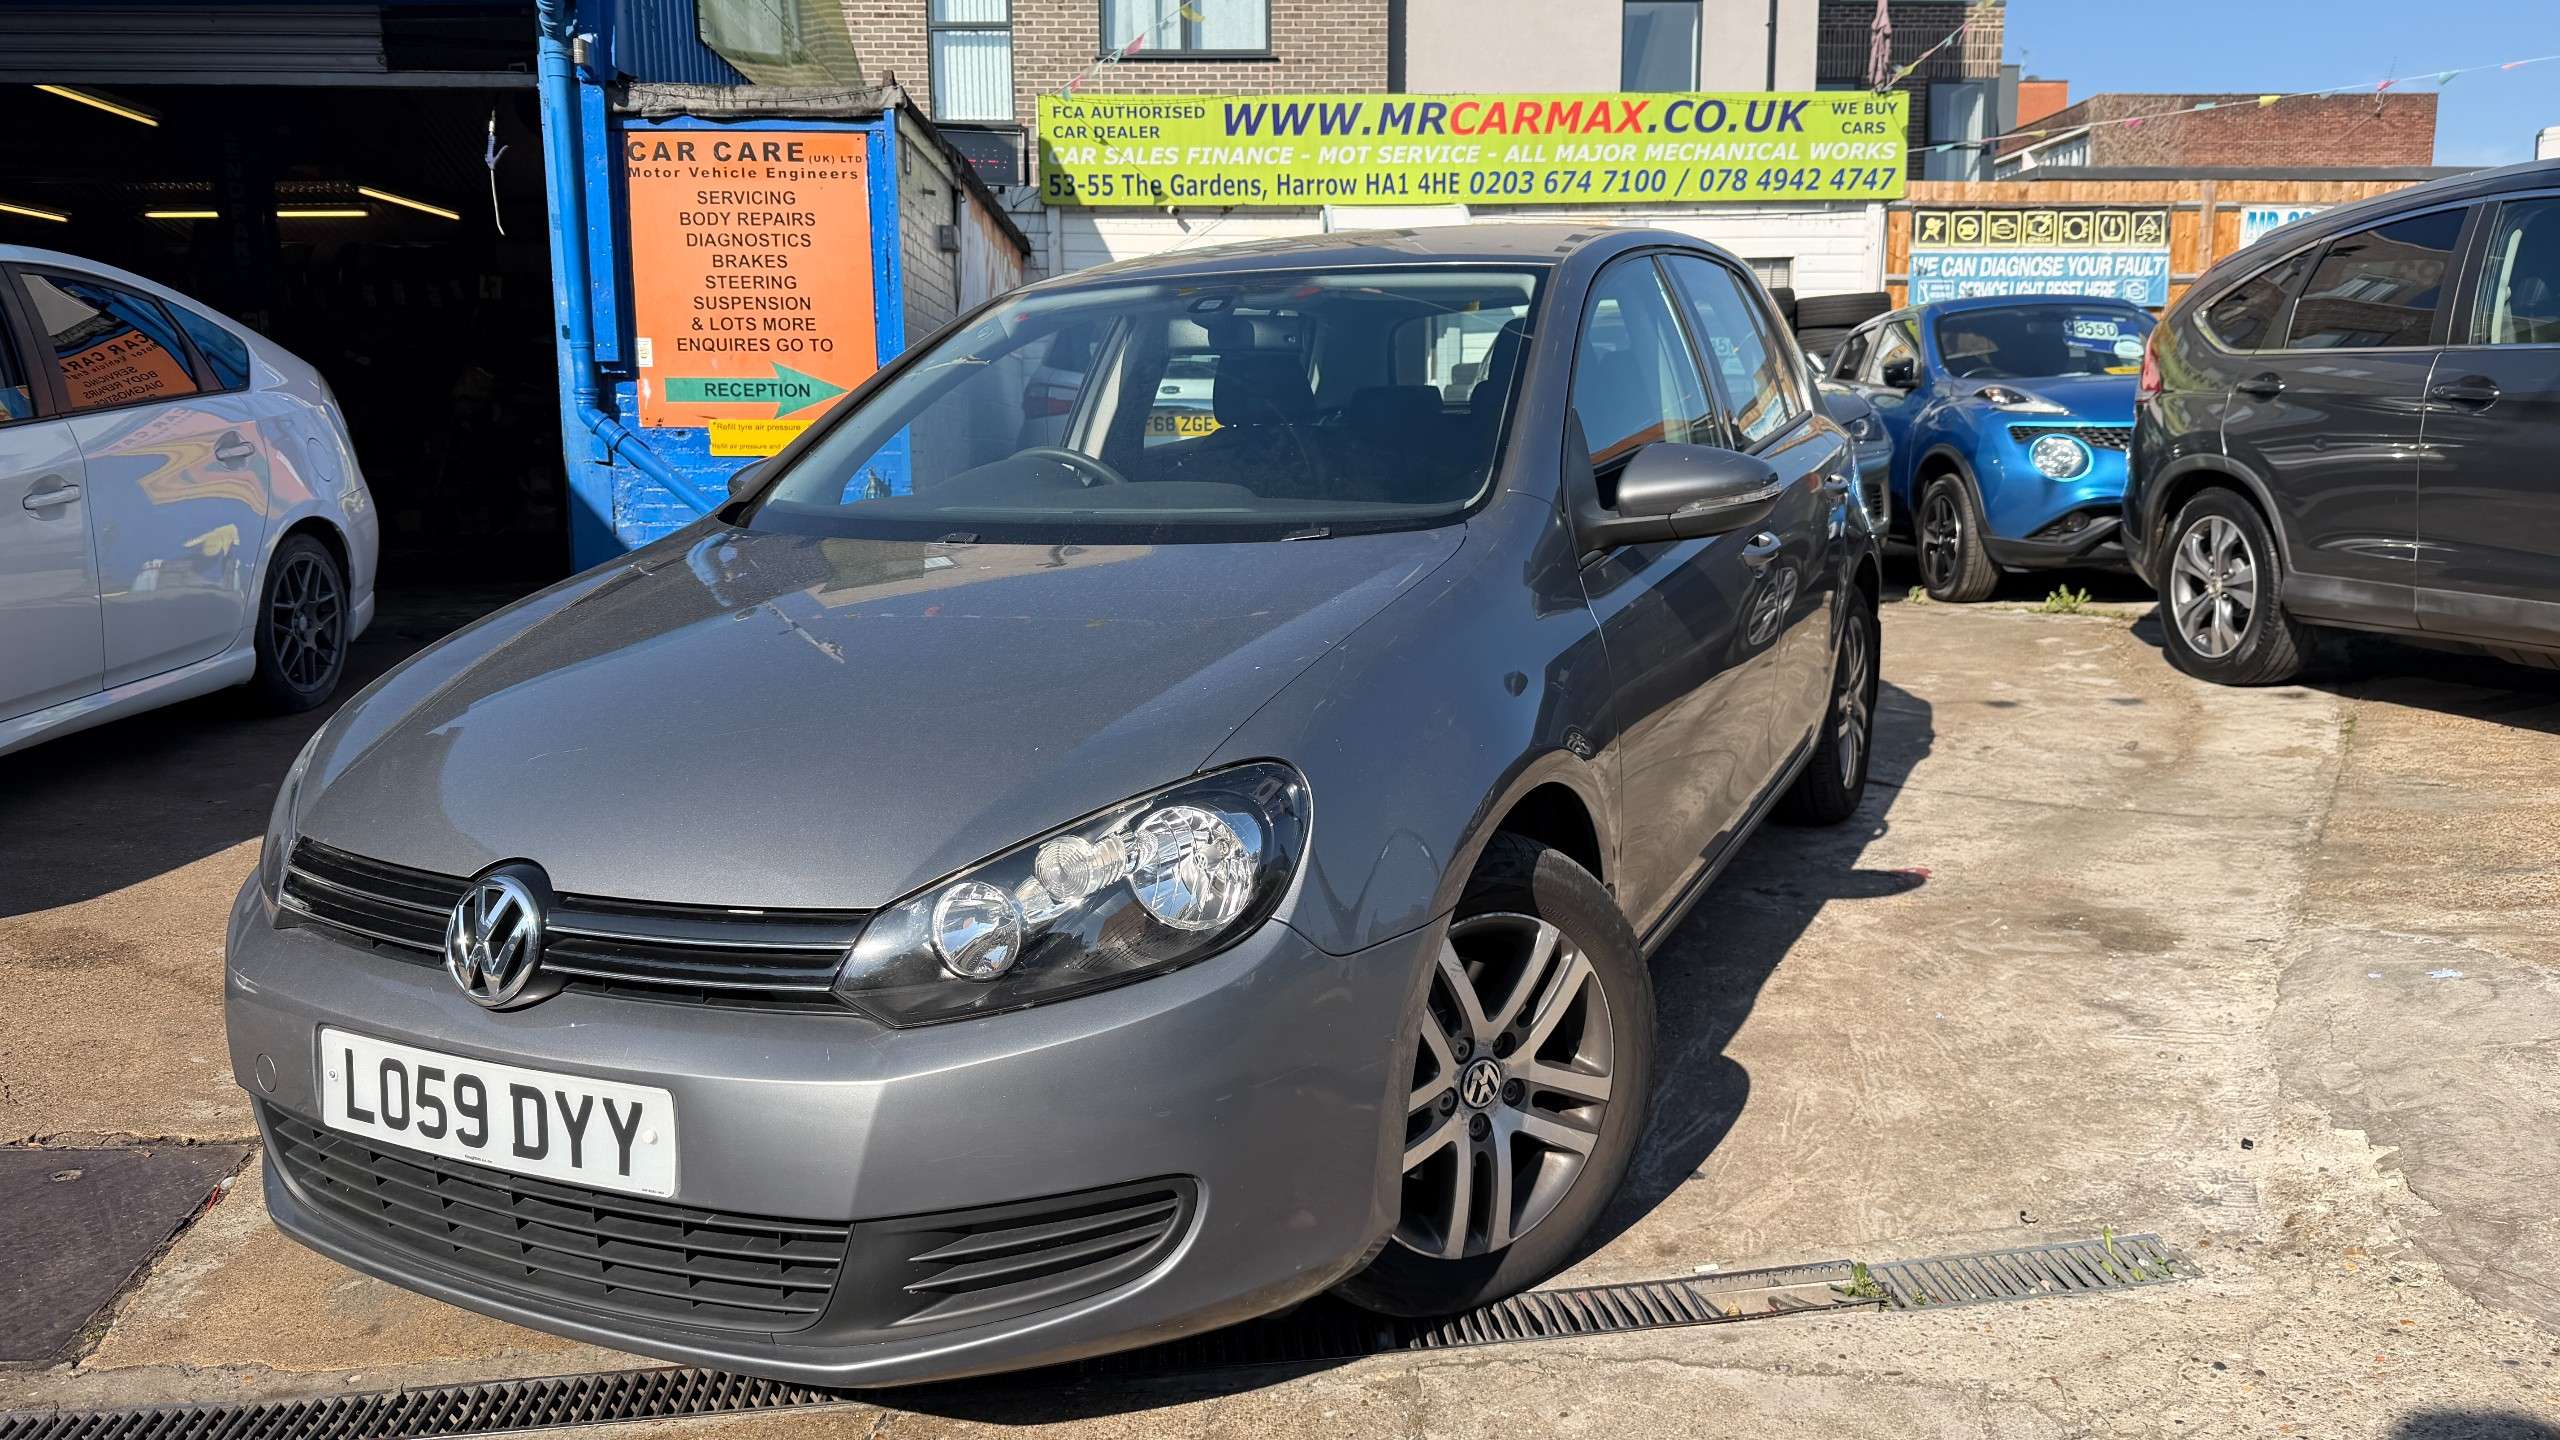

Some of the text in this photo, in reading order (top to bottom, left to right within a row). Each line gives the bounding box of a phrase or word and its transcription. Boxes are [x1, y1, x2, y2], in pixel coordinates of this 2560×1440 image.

[1053, 106, 1205, 119] FCA AUTHORISED
[1832, 102, 1897, 115] WE BUY
[1224, 100, 1809, 136] WWW.MRCARMAX.CO.UK
[1053, 126, 1160, 139] CAR DEALER
[1841, 121, 1885, 134] CARS
[628, 141, 862, 165] CAR CARE (UK) LTD
[1049, 148, 1097, 165] CAR
[1103, 147, 1178, 165] SALES
[1186, 147, 1293, 165] FINANCE
[1318, 146, 1374, 164] MOT
[1377, 145, 1479, 163] SERVICE
[1504, 145, 1547, 163] ALL
[1555, 144, 1636, 163] MAJOR
[1644, 143, 1800, 161] MECHANICAL
[1810, 142, 1897, 160] WORKS
[629, 167, 859, 182] Motor Vehicle Engineers
[1049, 168, 1896, 201] 53-55 The Gardens, Harrow HA1 4HE 0203 674 7100 / 078 4942 4747
[697, 191, 796, 205] SERVICING
[680, 212, 816, 227] BODY REPAIRS
[686, 233, 811, 248] DIAGNOSTICS
[712, 254, 788, 269] BRAKES
[1913, 256, 2166, 277] WE CAN DIAGNOSE YOUR FAULT
[705, 276, 797, 290] STEERING
[693, 297, 811, 311] SUSPENSION
[692, 317, 816, 331] & LOTS MORE
[677, 338, 833, 352] ENQUIRES GO TO
[704, 383, 810, 398] RECEPTION
[738, 423, 752, 432] tyre
[767, 424, 800, 432] pressure
[1181, 417, 1213, 431] ZGE
[345, 1047, 643, 1176] LO59 DYY
